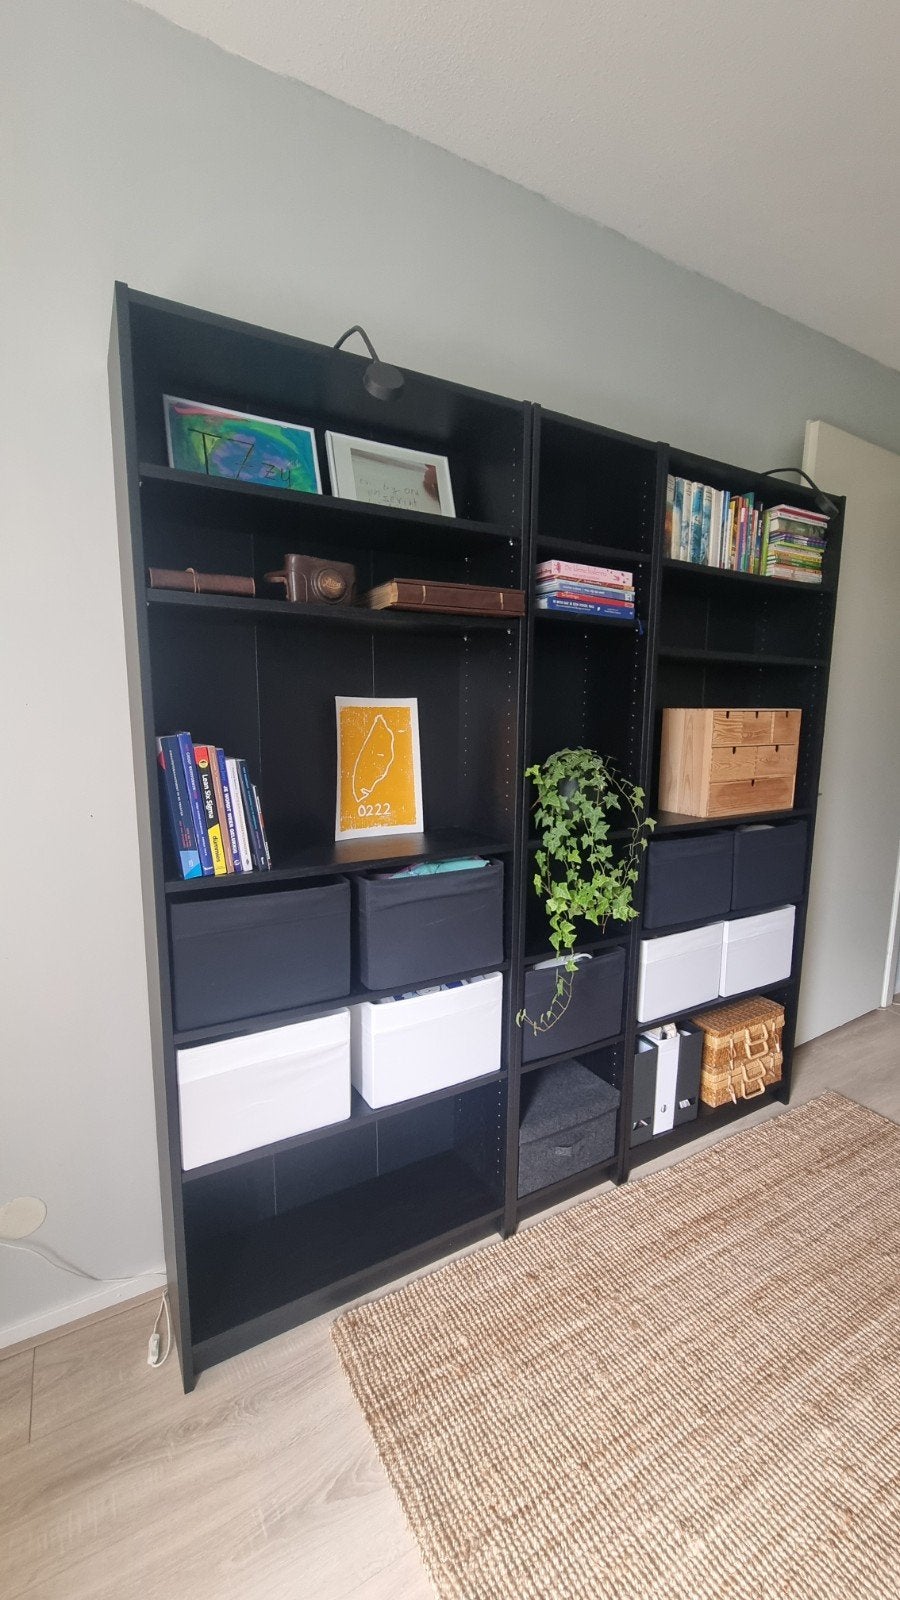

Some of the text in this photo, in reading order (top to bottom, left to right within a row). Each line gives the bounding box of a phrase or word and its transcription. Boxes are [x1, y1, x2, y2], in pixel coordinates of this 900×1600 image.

[202, 774, 210, 790] Lean
[206, 800, 214, 818] Sigma
[358, 803, 391, 817] 0222
[213, 835, 221, 862] dummies
[229, 828, 238, 854] GELUKKIG
